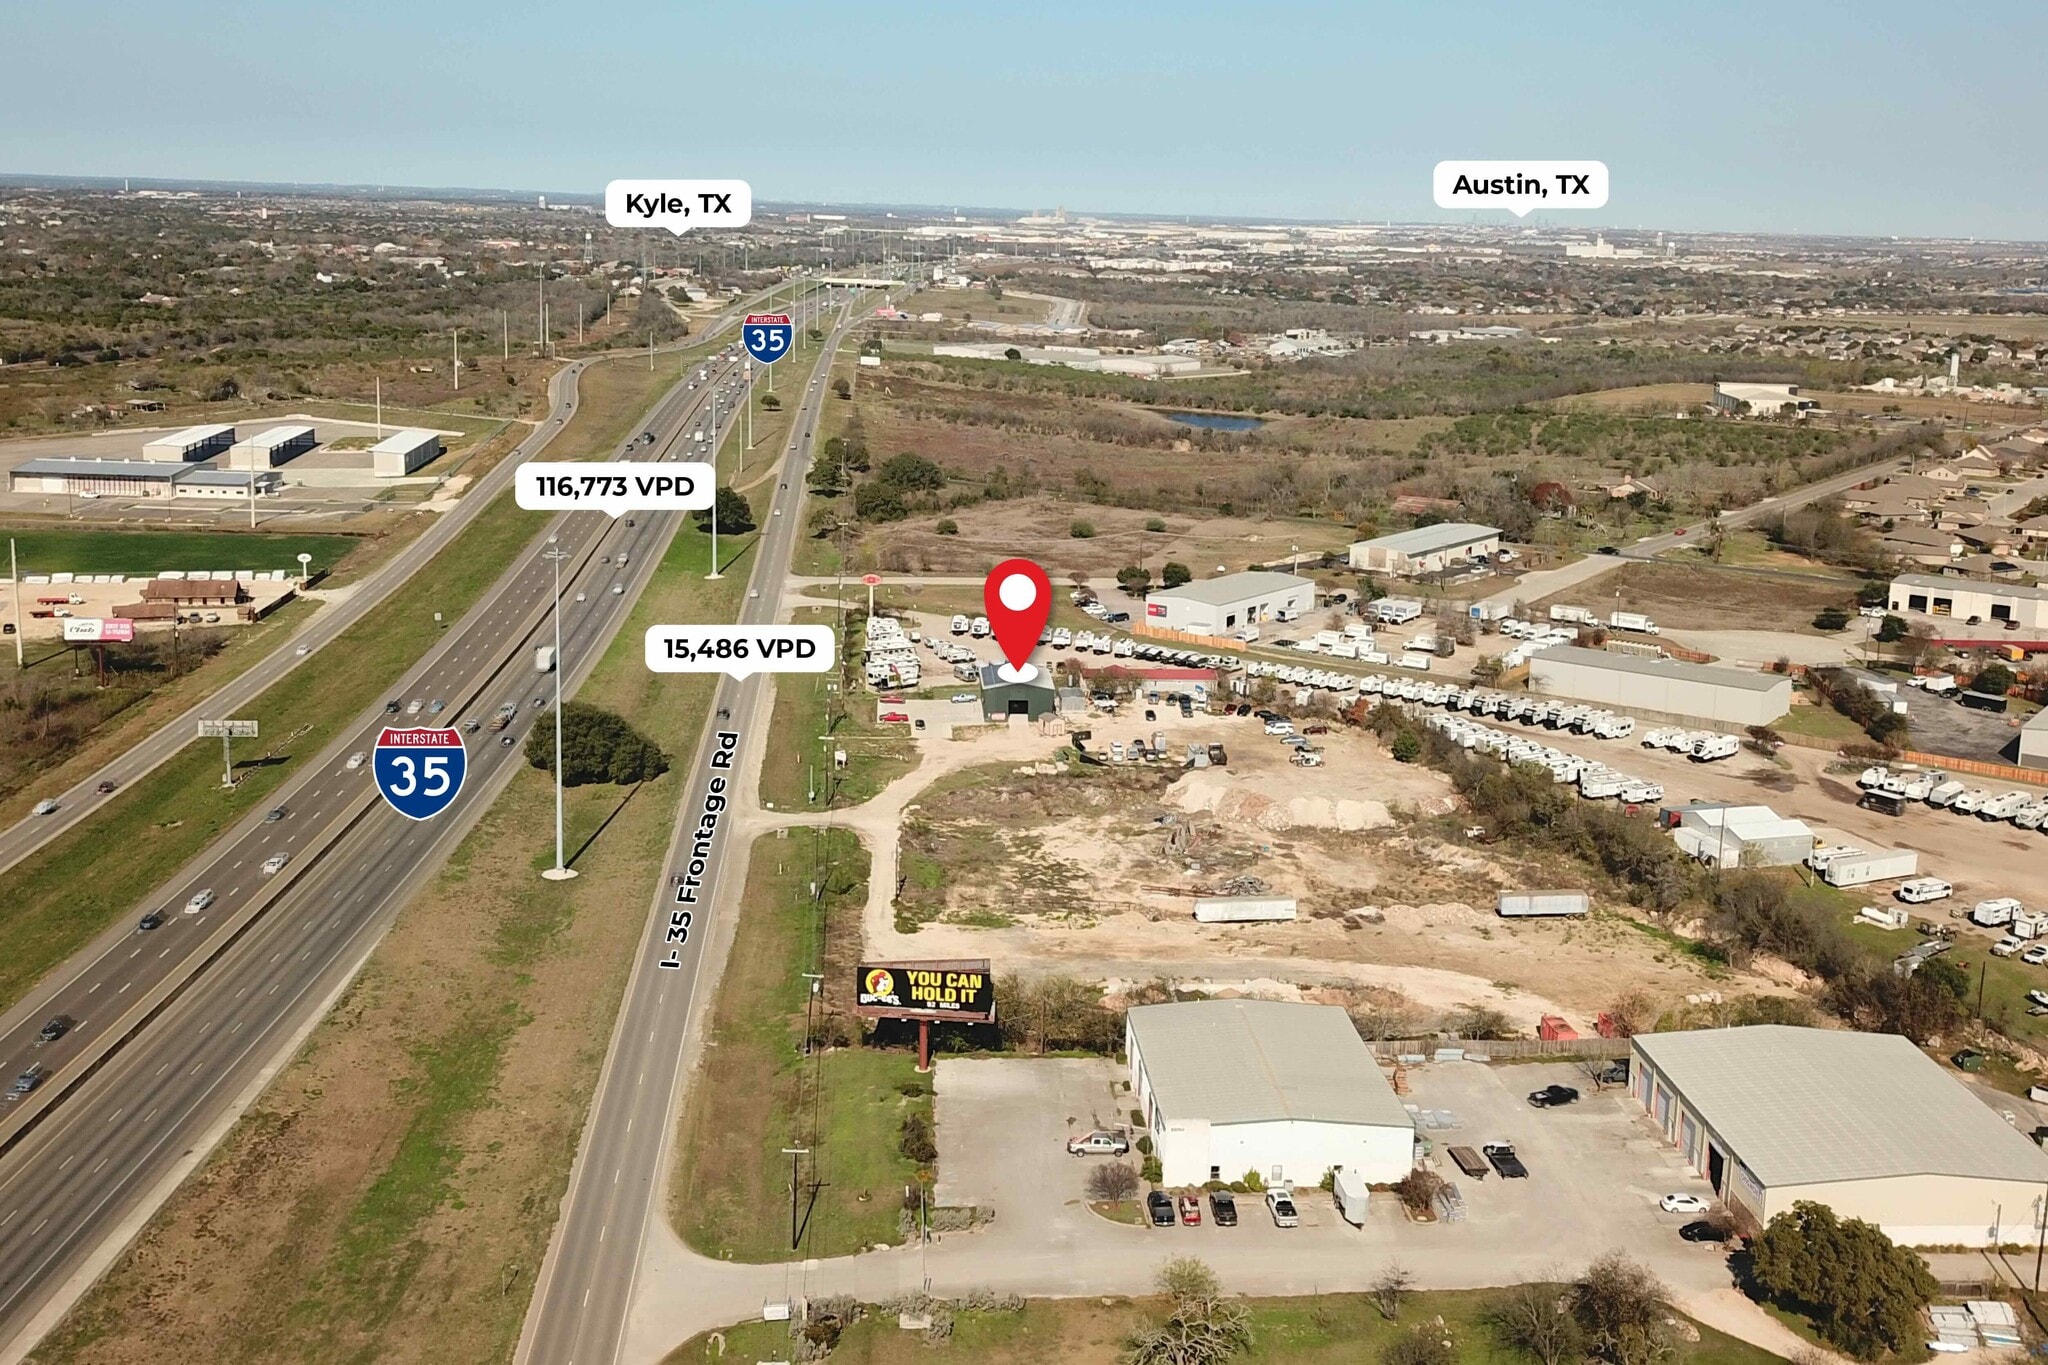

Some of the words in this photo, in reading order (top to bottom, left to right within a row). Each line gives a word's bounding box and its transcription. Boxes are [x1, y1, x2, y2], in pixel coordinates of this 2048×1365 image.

[907, 971, 941, 986] YOU
[946, 973, 982, 989] CAN
[911, 986, 957, 1002] HOLD
[960, 989, 977, 1003] IT
